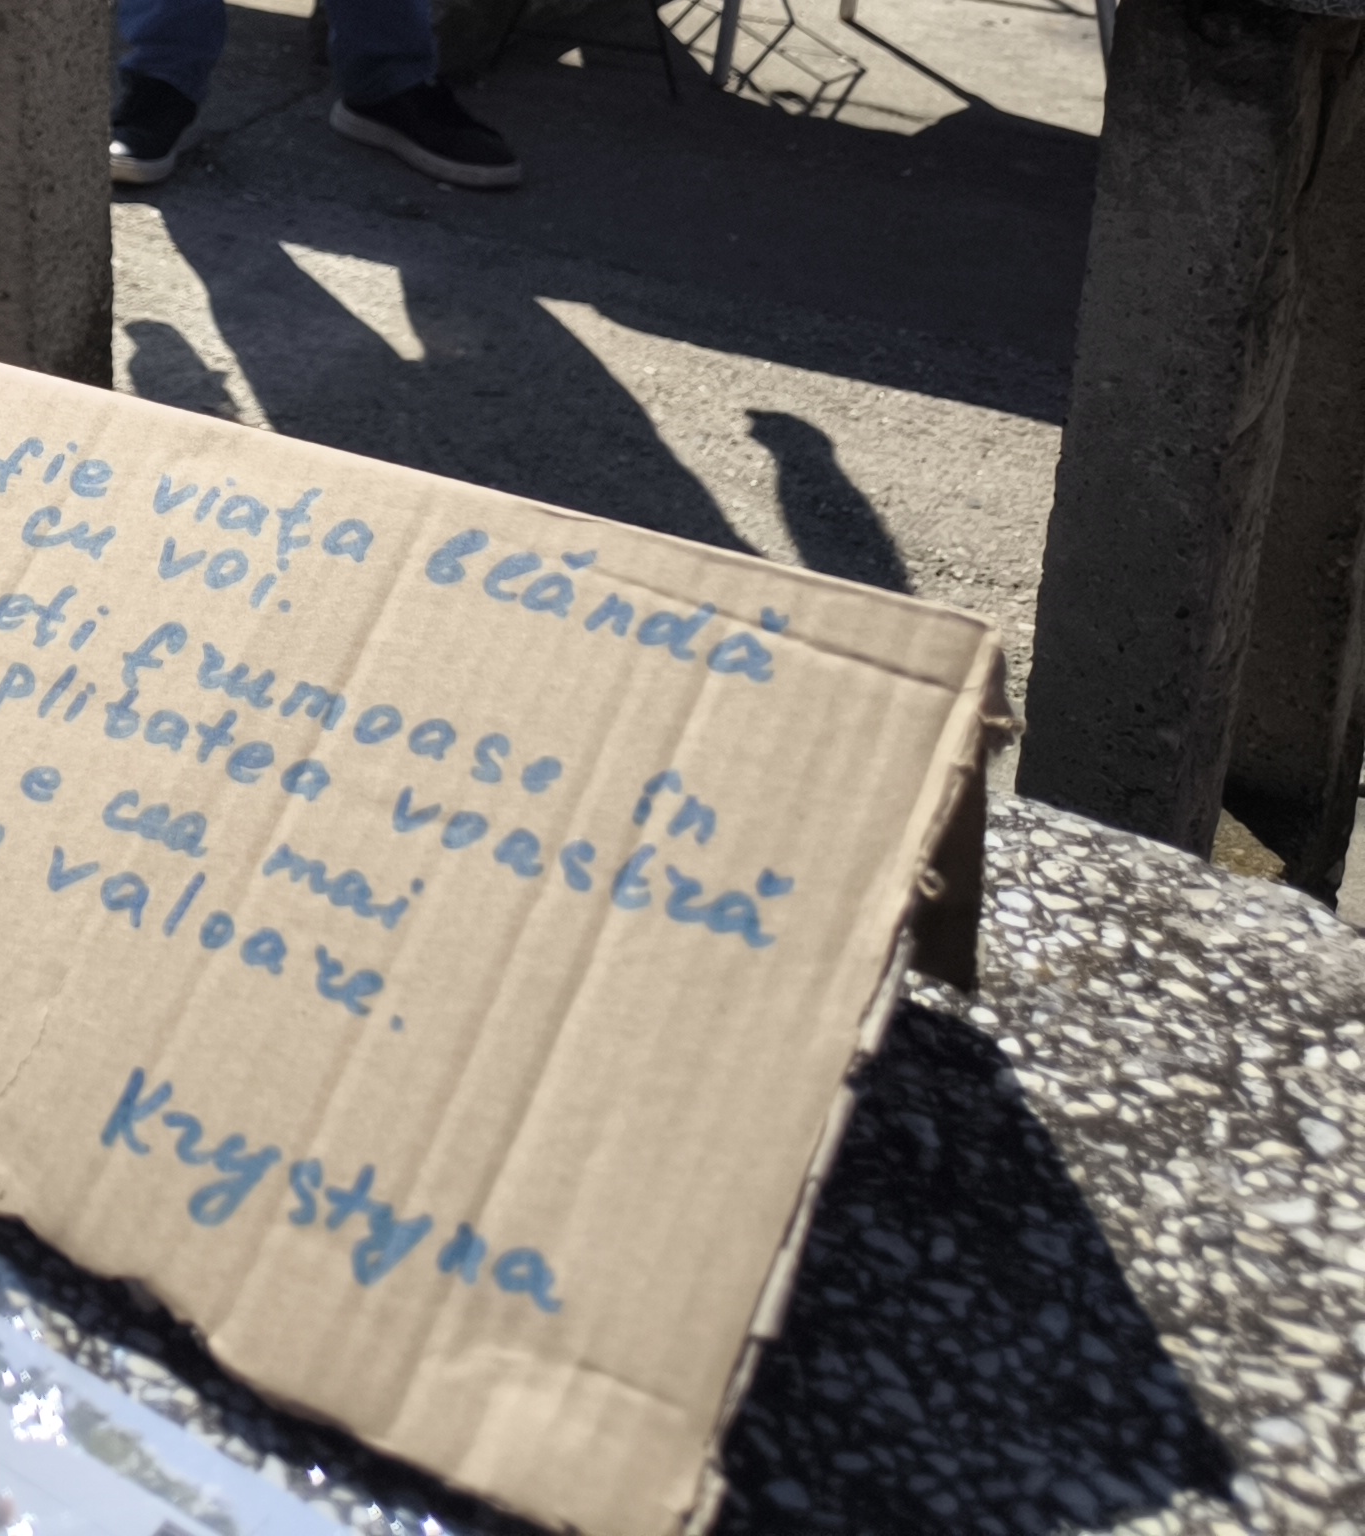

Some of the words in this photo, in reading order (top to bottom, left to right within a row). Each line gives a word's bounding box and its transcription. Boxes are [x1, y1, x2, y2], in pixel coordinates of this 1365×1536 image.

[21, 507, 116, 560] cu
[158, 537, 291, 613] voi.
[153, 473, 373, 564] viața
[121, 622, 563, 795] frumoase
[633, 770, 717, 845] în
[20, 767, 62, 804] e
[103, 791, 208, 858] cea
[262, 845, 426, 930] mai
[393, 788, 795, 950] voastră
[47, 848, 404, 1031] valoare.
[100, 1068, 562, 1315] Krystyna
